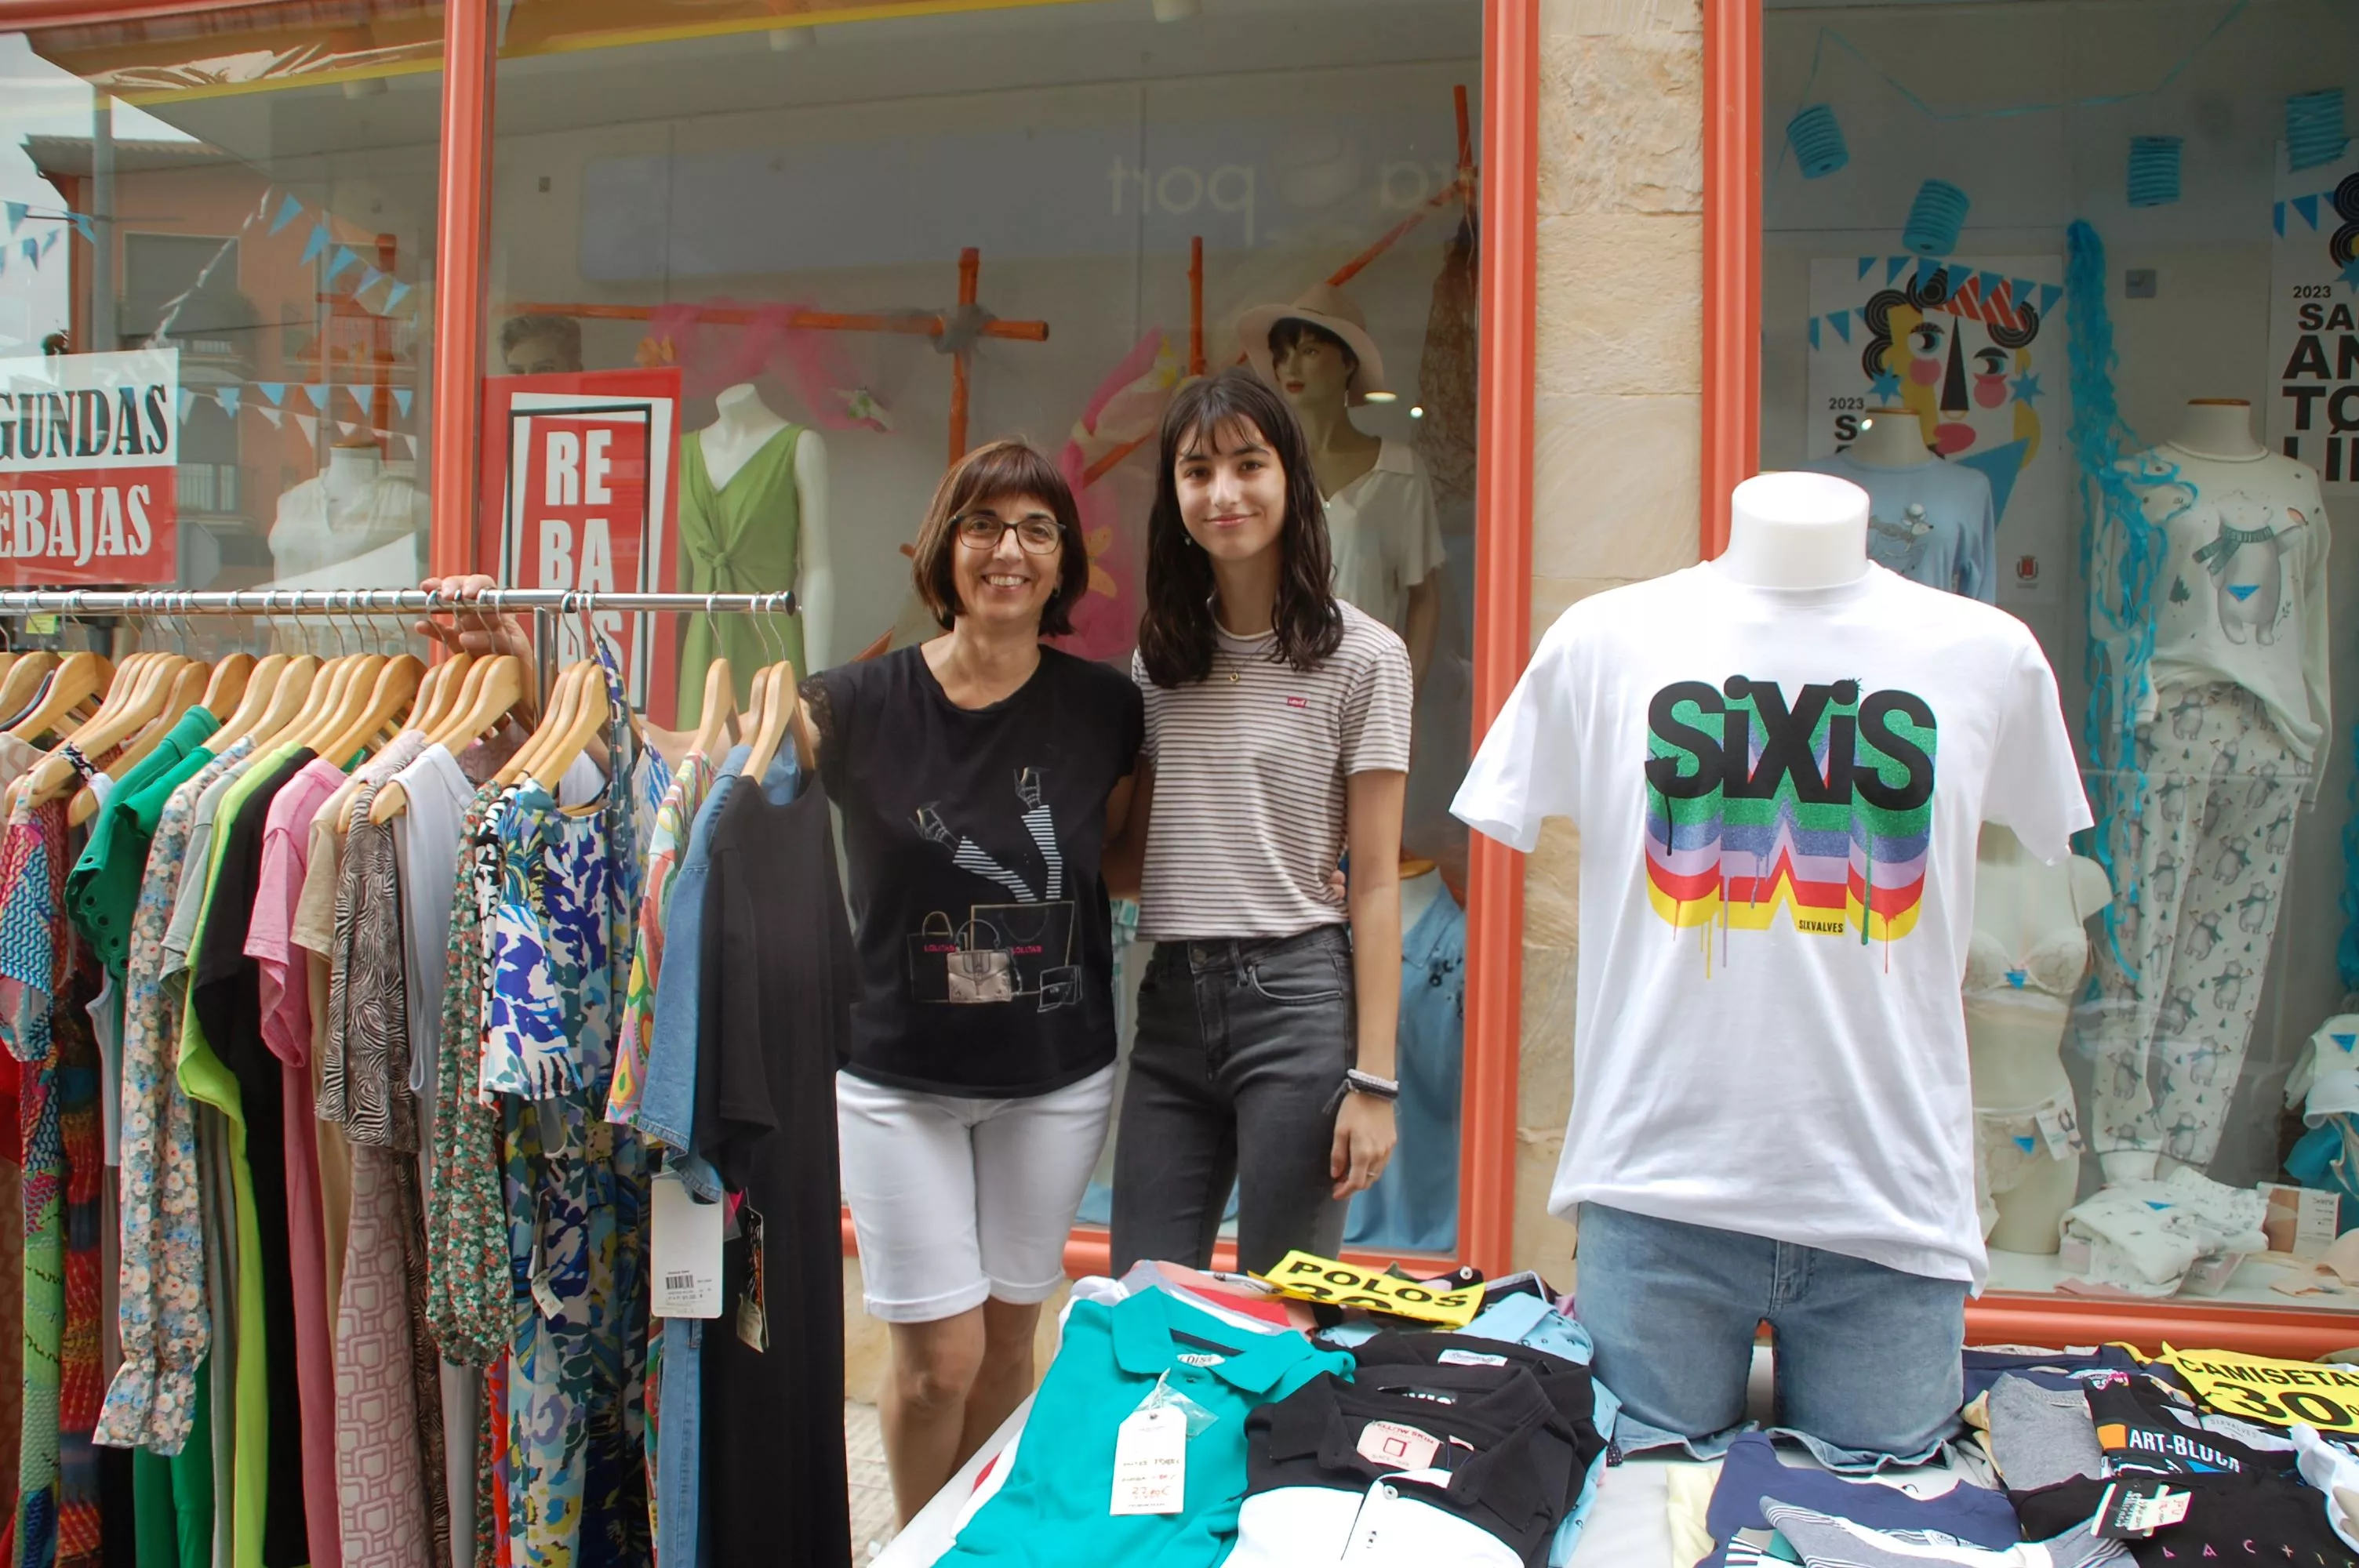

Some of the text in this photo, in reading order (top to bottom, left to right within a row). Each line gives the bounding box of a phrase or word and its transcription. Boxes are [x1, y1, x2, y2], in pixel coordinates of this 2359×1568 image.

[2292, 285, 2332, 299] 2023
[2297, 303, 2359, 332] SA
[1828, 397, 1865, 410] 2023
[545, 429, 612, 506] RE
[1798, 919, 1844, 934] SIXVALVES
[1286, 1261, 1469, 1308] POLOS
[2176, 1356, 2359, 1388] CAMISETA
